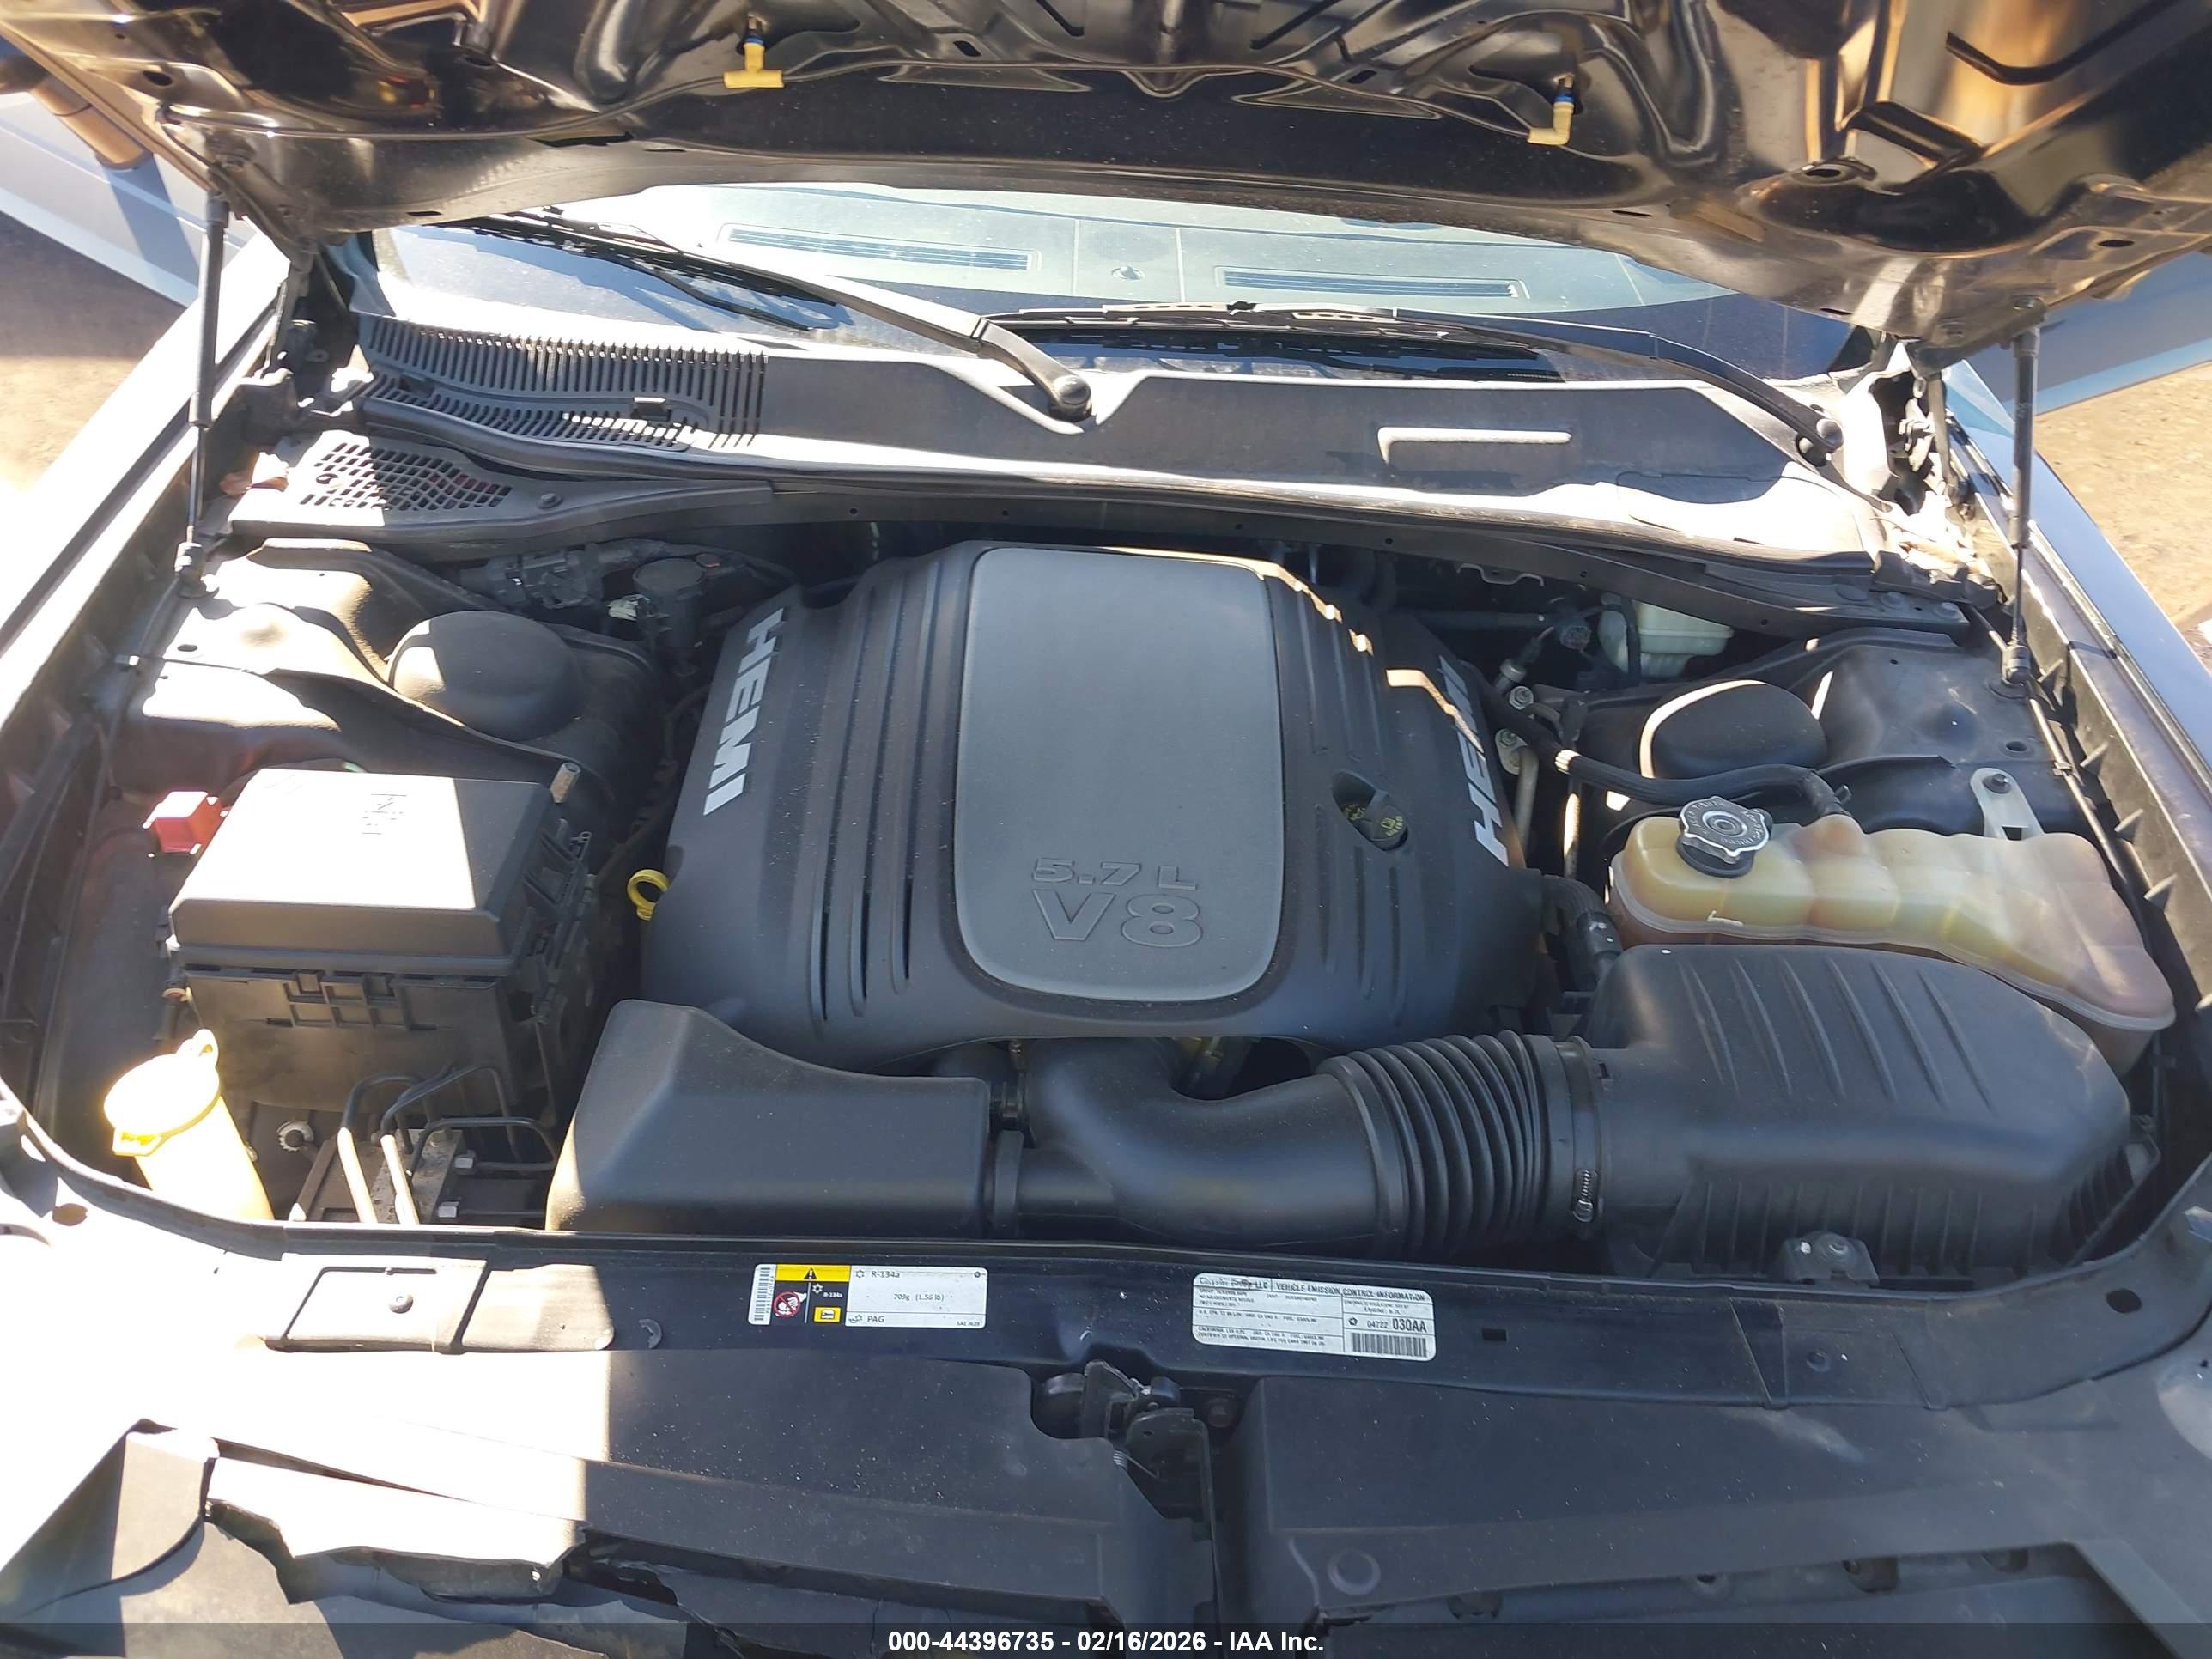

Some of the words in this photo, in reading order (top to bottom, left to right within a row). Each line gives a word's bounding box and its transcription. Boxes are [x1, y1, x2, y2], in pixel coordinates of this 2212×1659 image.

[703, 607, 784, 816] HEMI
[1438, 654, 1510, 867] HEMI
[1030, 888, 1204, 948] V8
[871, 1269, 900, 1279] R-134a
[893, 1293, 910, 1302] 709g
[1276, 1282, 1305, 1292] VEHICLE
[1307, 1285, 1341, 1296] EMISSION
[1342, 1288, 1374, 1297] CONTROL
[1376, 1291, 1425, 1302] INFORMATION
[867, 1316, 884, 1324] PAG
[1366, 1320, 1389, 1328] 04722
[1392, 1317, 1428, 1333] 030AA
